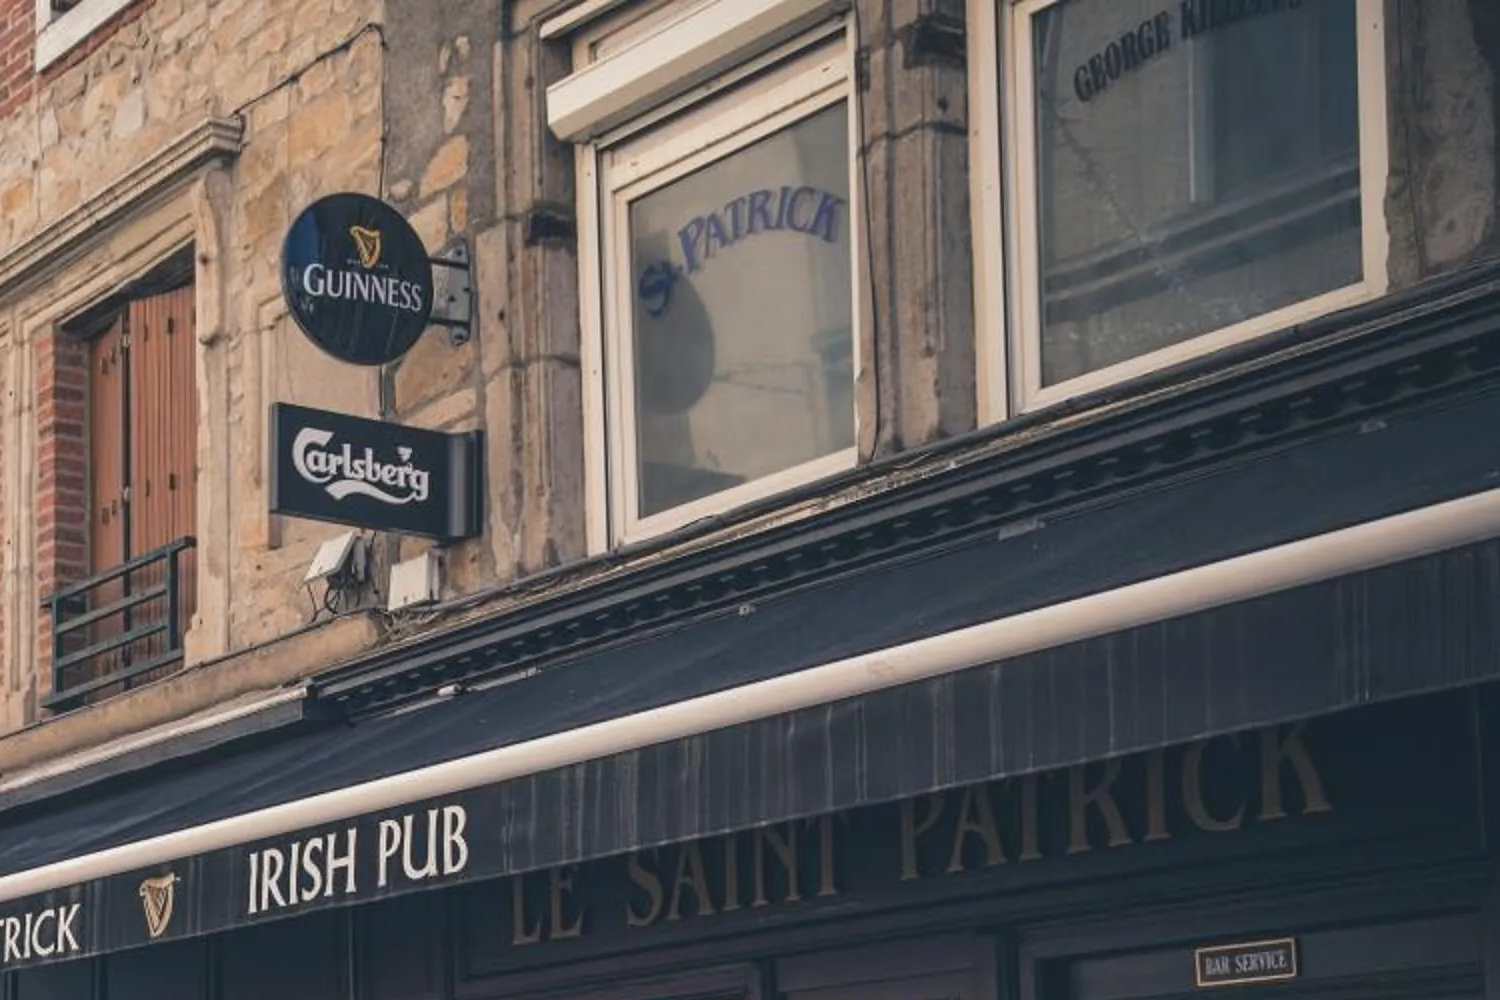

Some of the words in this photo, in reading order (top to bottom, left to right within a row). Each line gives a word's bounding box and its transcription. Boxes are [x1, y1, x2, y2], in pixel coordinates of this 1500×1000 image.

[1073, 10, 1172, 103] GEORGE
[677, 186, 847, 275] PATRICK
[303, 263, 423, 312] GUINNESS
[292, 427, 430, 504] Carlsberg
[248, 828, 357, 914] IRISH
[377, 805, 469, 887] PUB
[1205, 956, 1231, 976] BAR
[1235, 949, 1288, 973] SERVICE
